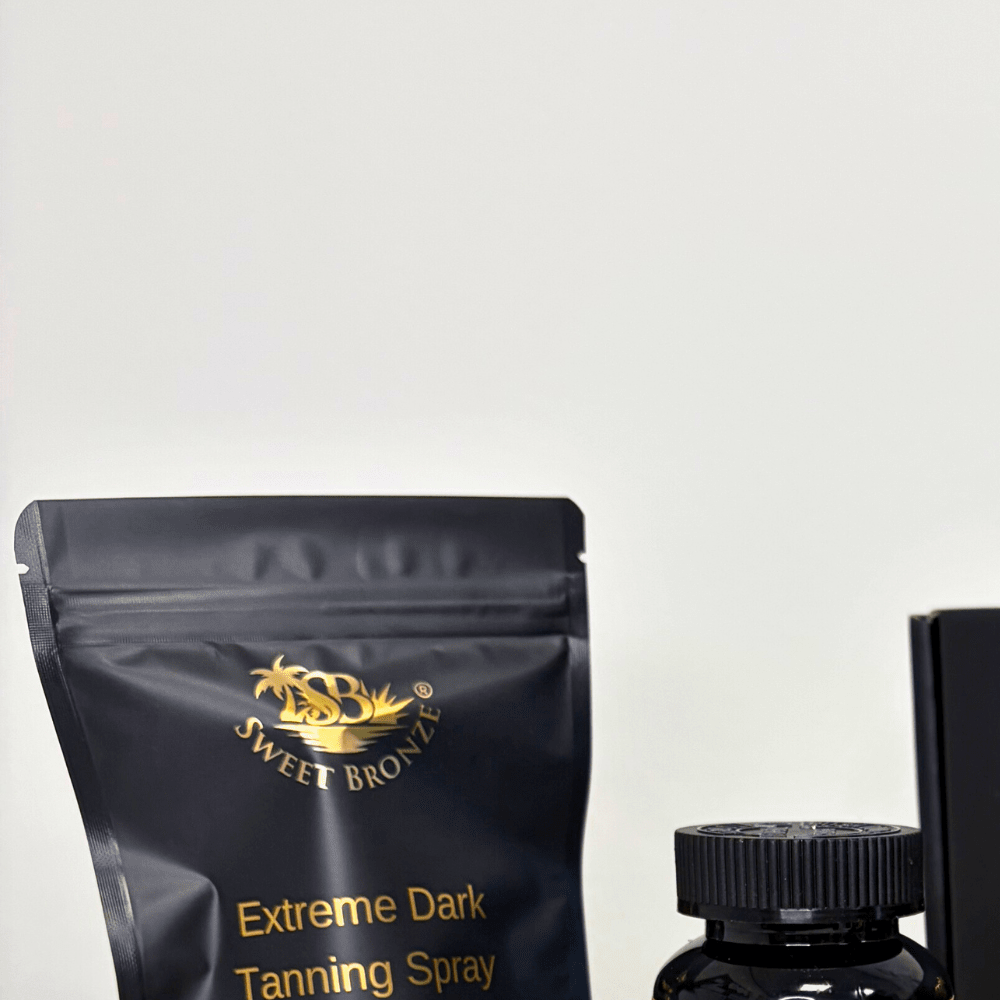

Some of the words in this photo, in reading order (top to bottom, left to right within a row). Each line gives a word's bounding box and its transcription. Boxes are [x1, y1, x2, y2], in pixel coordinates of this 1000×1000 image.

[235, 716, 335, 790] SWEET
[343, 704, 441, 792] BRONZE
[237, 894, 397, 938] Extreme
[407, 884, 487, 921] Dark
[406, 951, 496, 994] Spray
